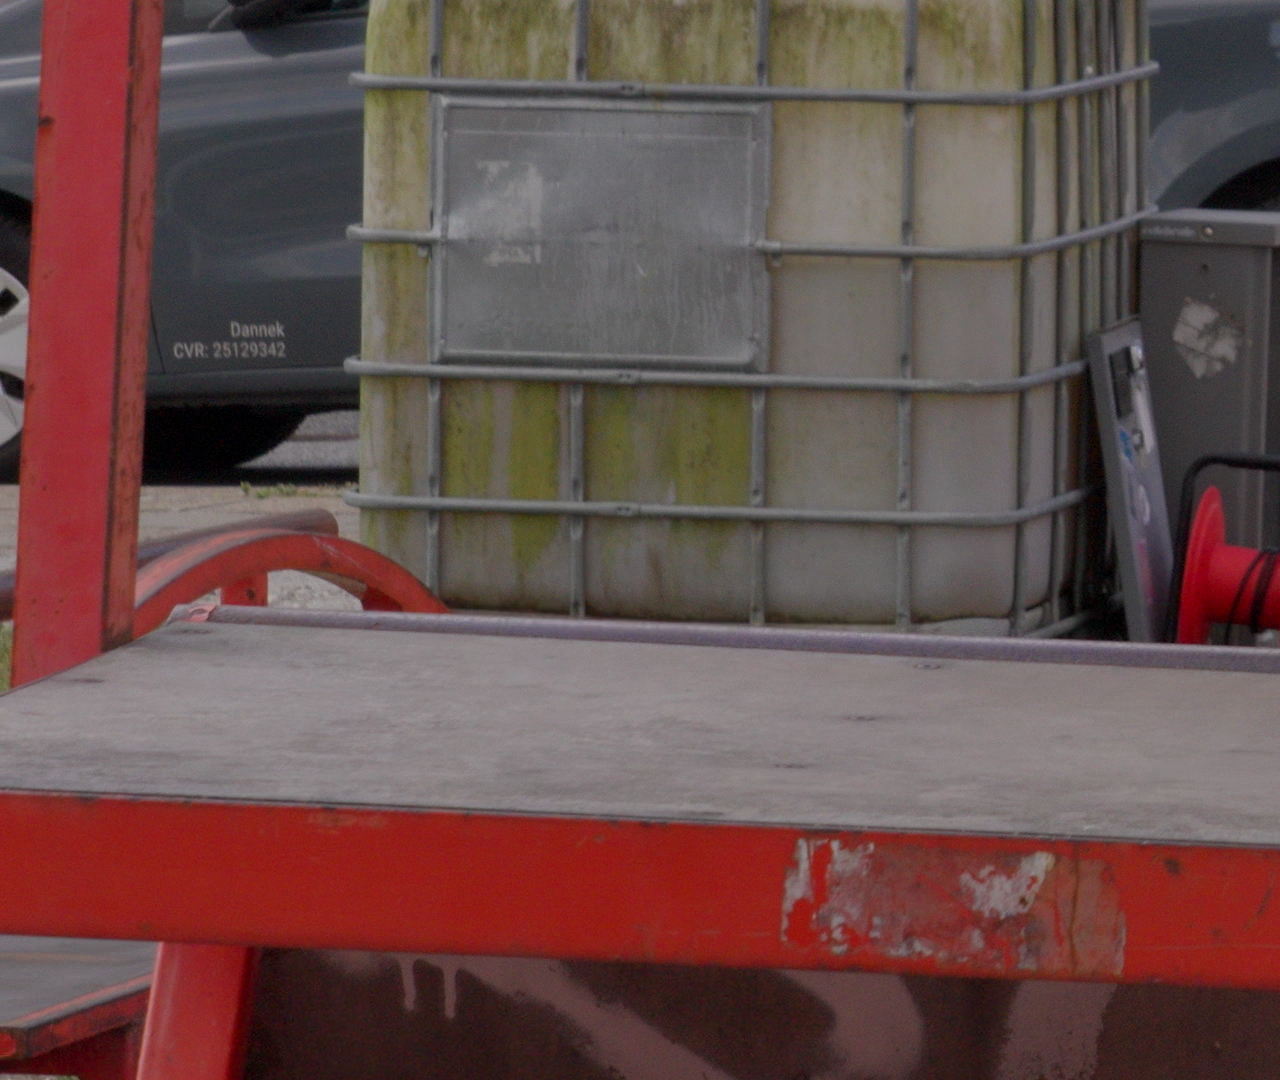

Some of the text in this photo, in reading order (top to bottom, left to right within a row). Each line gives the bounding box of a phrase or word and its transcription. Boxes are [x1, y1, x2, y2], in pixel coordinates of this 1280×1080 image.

[230, 320, 285, 338] Dannek
[173, 341, 286, 360] CVR: 25129342
